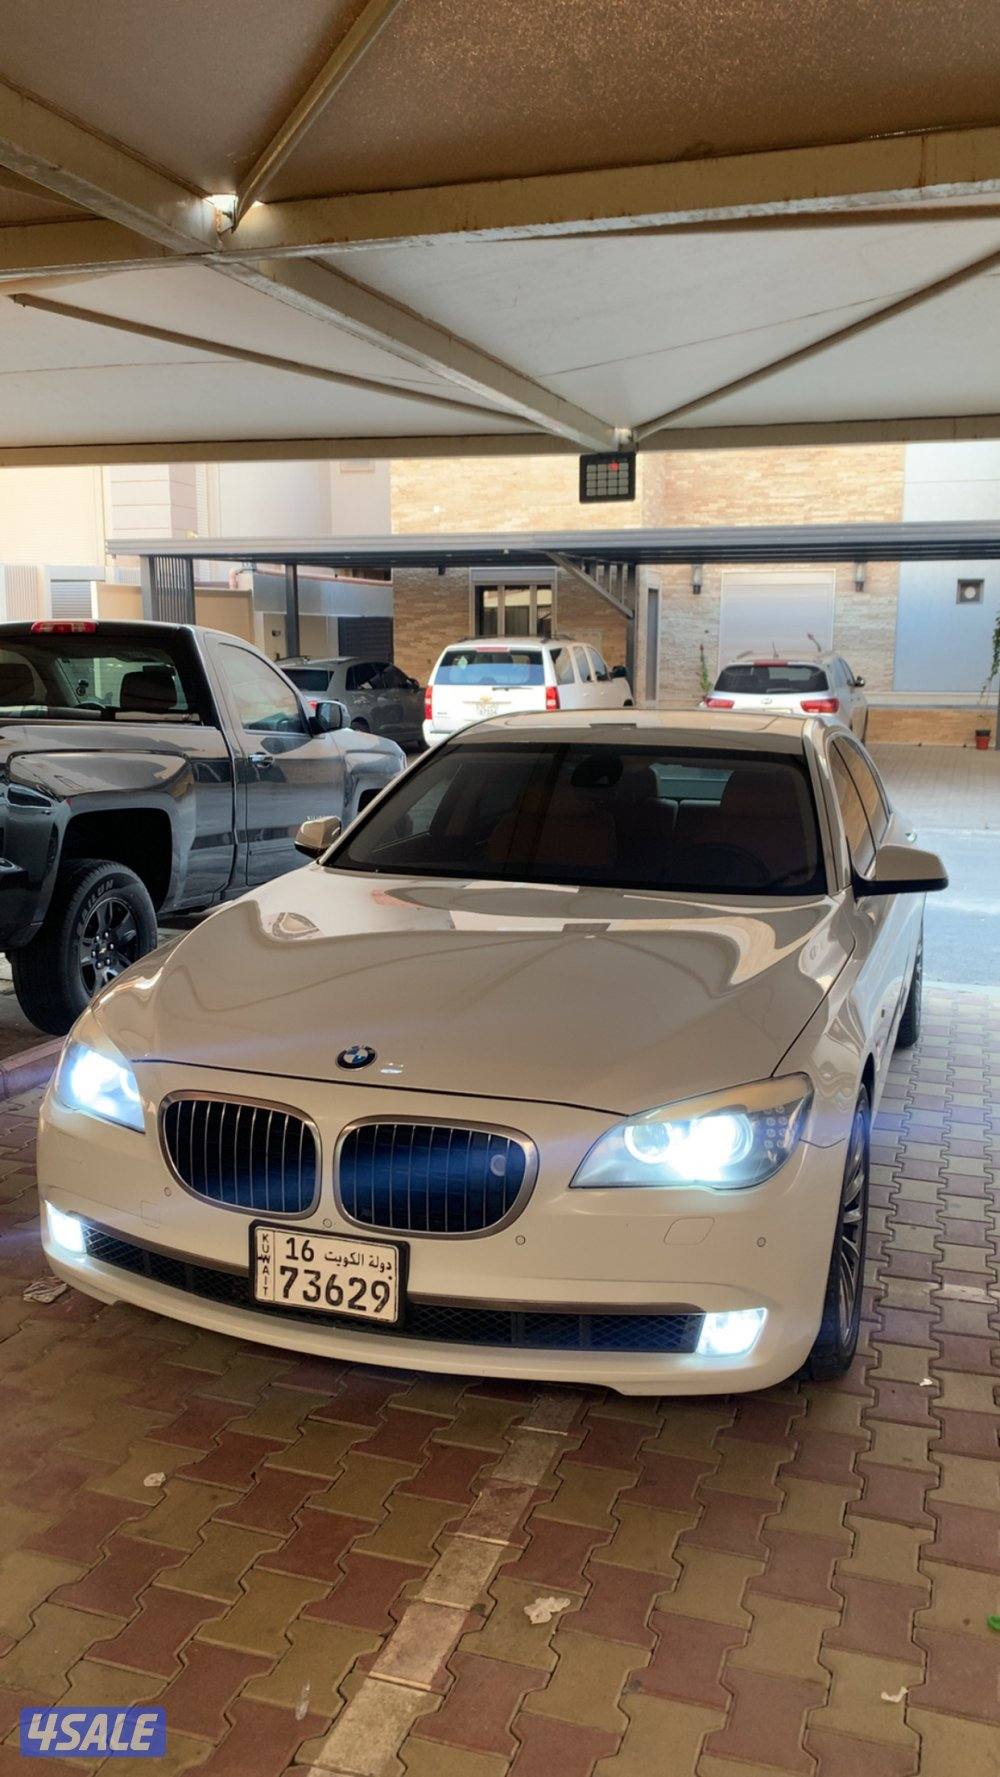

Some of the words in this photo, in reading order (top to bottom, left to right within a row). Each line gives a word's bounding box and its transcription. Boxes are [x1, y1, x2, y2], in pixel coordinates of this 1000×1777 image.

[286, 1237, 314, 1262] 16
[324, 1250, 365, 1267] الكويت
[262, 1233, 271, 1295] KUWAIT
[368, 1254, 392, 1273] دولة
[280, 1265, 390, 1313] 73629
